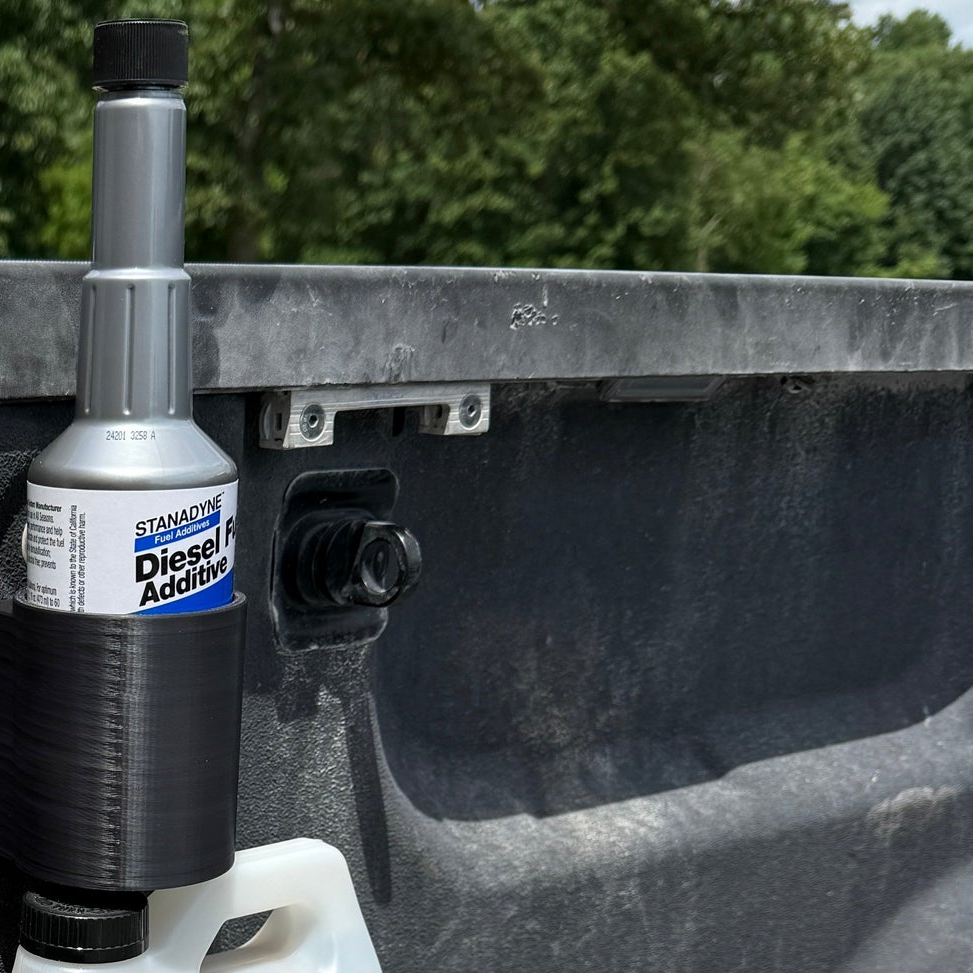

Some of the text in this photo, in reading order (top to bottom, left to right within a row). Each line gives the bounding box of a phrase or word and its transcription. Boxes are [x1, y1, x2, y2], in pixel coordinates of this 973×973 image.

[106, 430, 126, 441] 24201
[150, 430, 156, 441] A
[154, 520, 210, 545] Fuel Additives
[135, 526, 221, 583] Diesel
[139, 556, 228, 607] Additive
